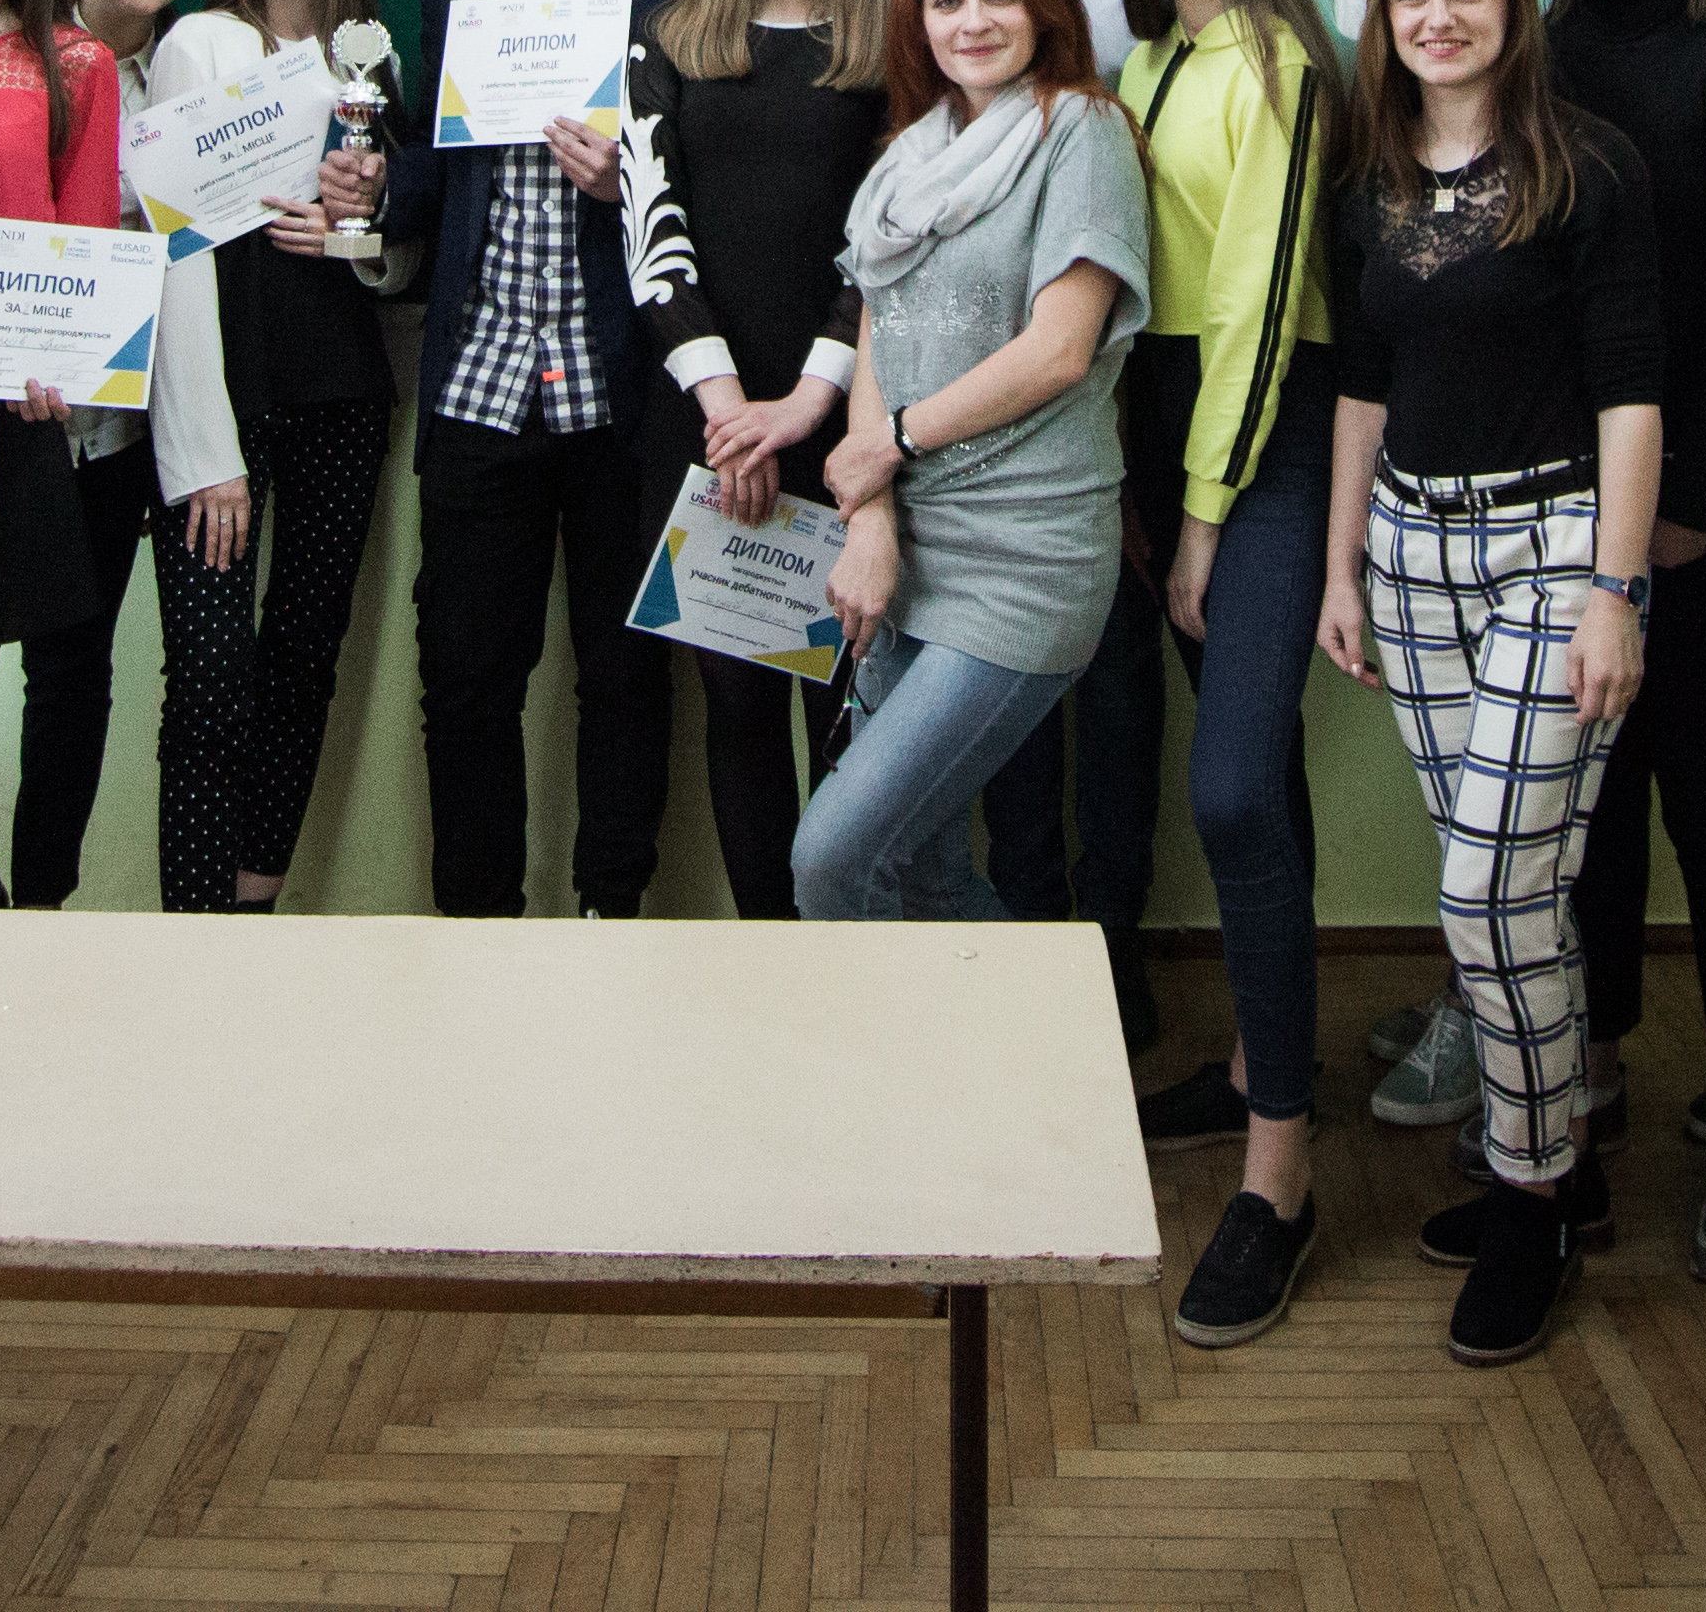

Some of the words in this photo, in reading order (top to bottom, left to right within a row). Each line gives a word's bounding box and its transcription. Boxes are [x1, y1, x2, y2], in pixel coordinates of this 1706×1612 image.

[458, 19, 483, 28] USAID
[498, 33, 576, 58] ДИПЛОМ
[531, 60, 560, 71] МІСЦЕ
[185, 96, 207, 114] NDI
[130, 129, 162, 148] USAID
[195, 100, 285, 158] ДИПЛОМ
[242, 131, 277, 153] МІСЦЕ
[199, 171, 235, 192] дебатному
[260, 134, 315, 162] нагороджується
[0, 229, 25, 241] NDI
[32, 304, 73, 319] МІСЦЕ
[15, 324, 43, 335] турнірі
[44, 328, 112, 340] нагороджується
[722, 534, 815, 578] ДИПЛОМ
[732, 566, 787, 587] нагороджується
[689, 568, 730, 587] учасник
[731, 580, 782, 603] дебатного
[784, 595, 821, 616] турніру
